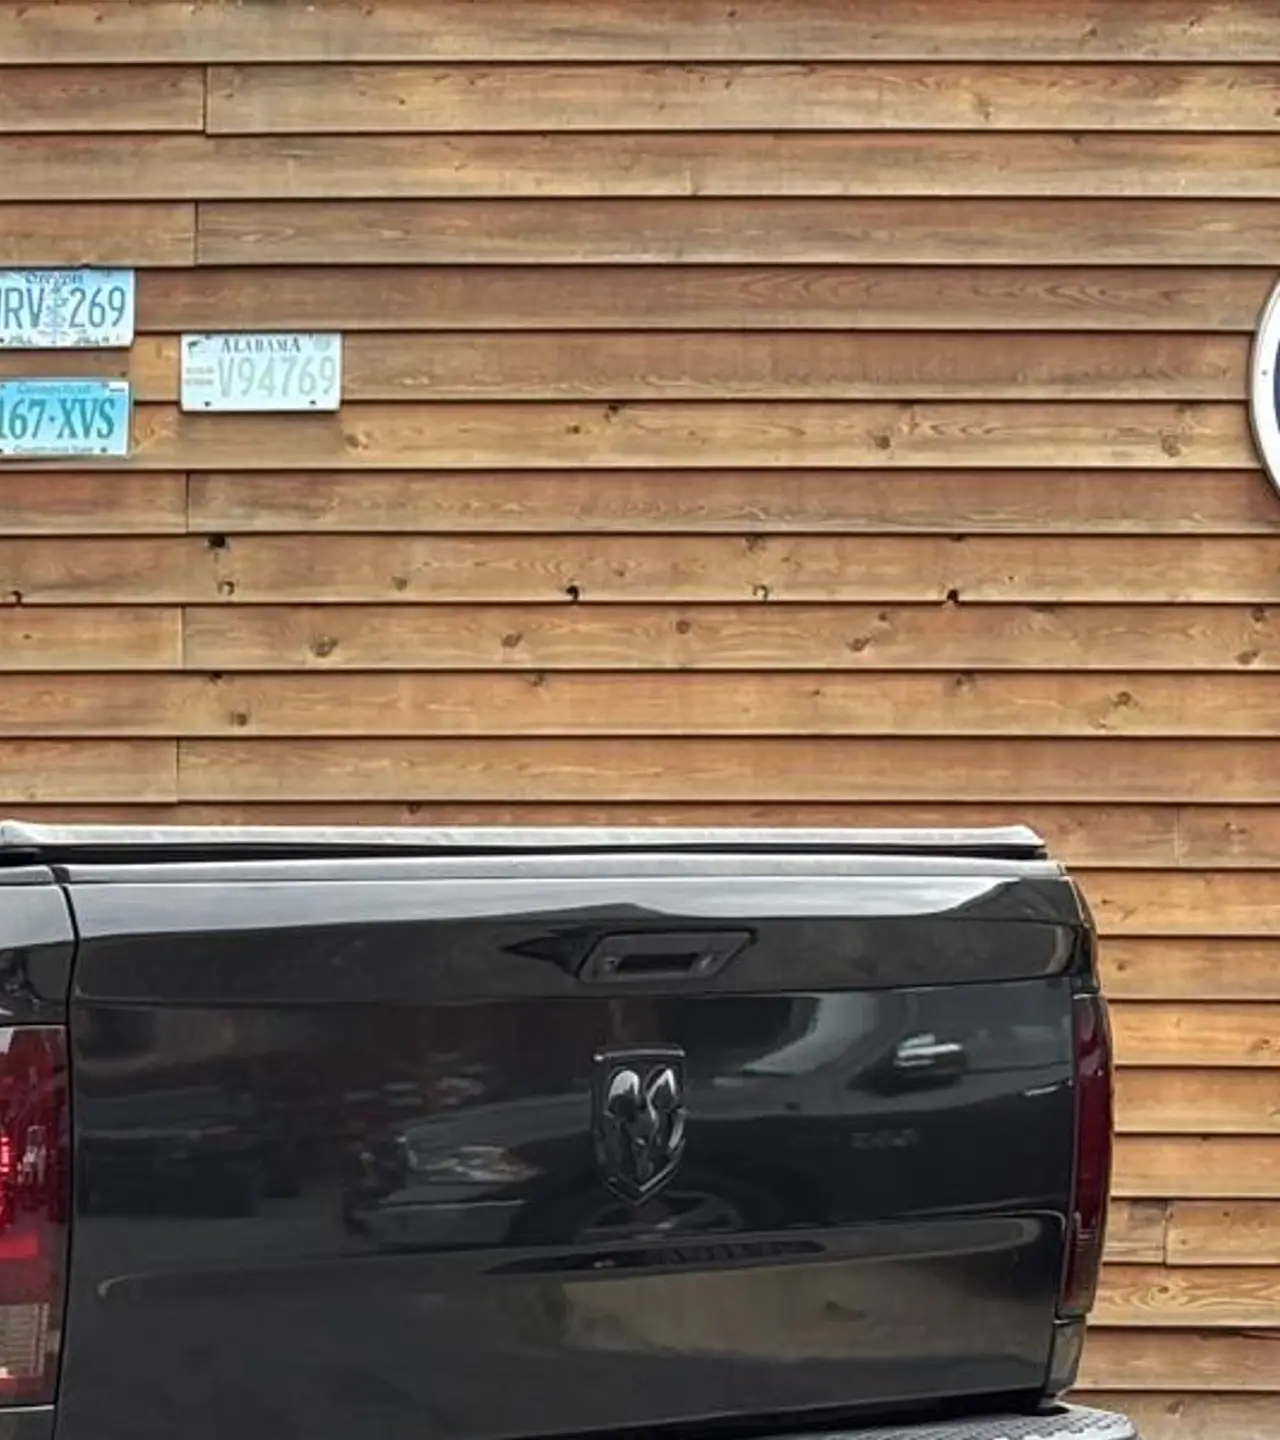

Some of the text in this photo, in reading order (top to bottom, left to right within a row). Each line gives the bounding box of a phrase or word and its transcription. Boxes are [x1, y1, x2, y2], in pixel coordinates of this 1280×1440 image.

[68, 286, 126, 328] 269
[222, 337, 302, 353] ALABAMA
[218, 356, 336, 397] V94769
